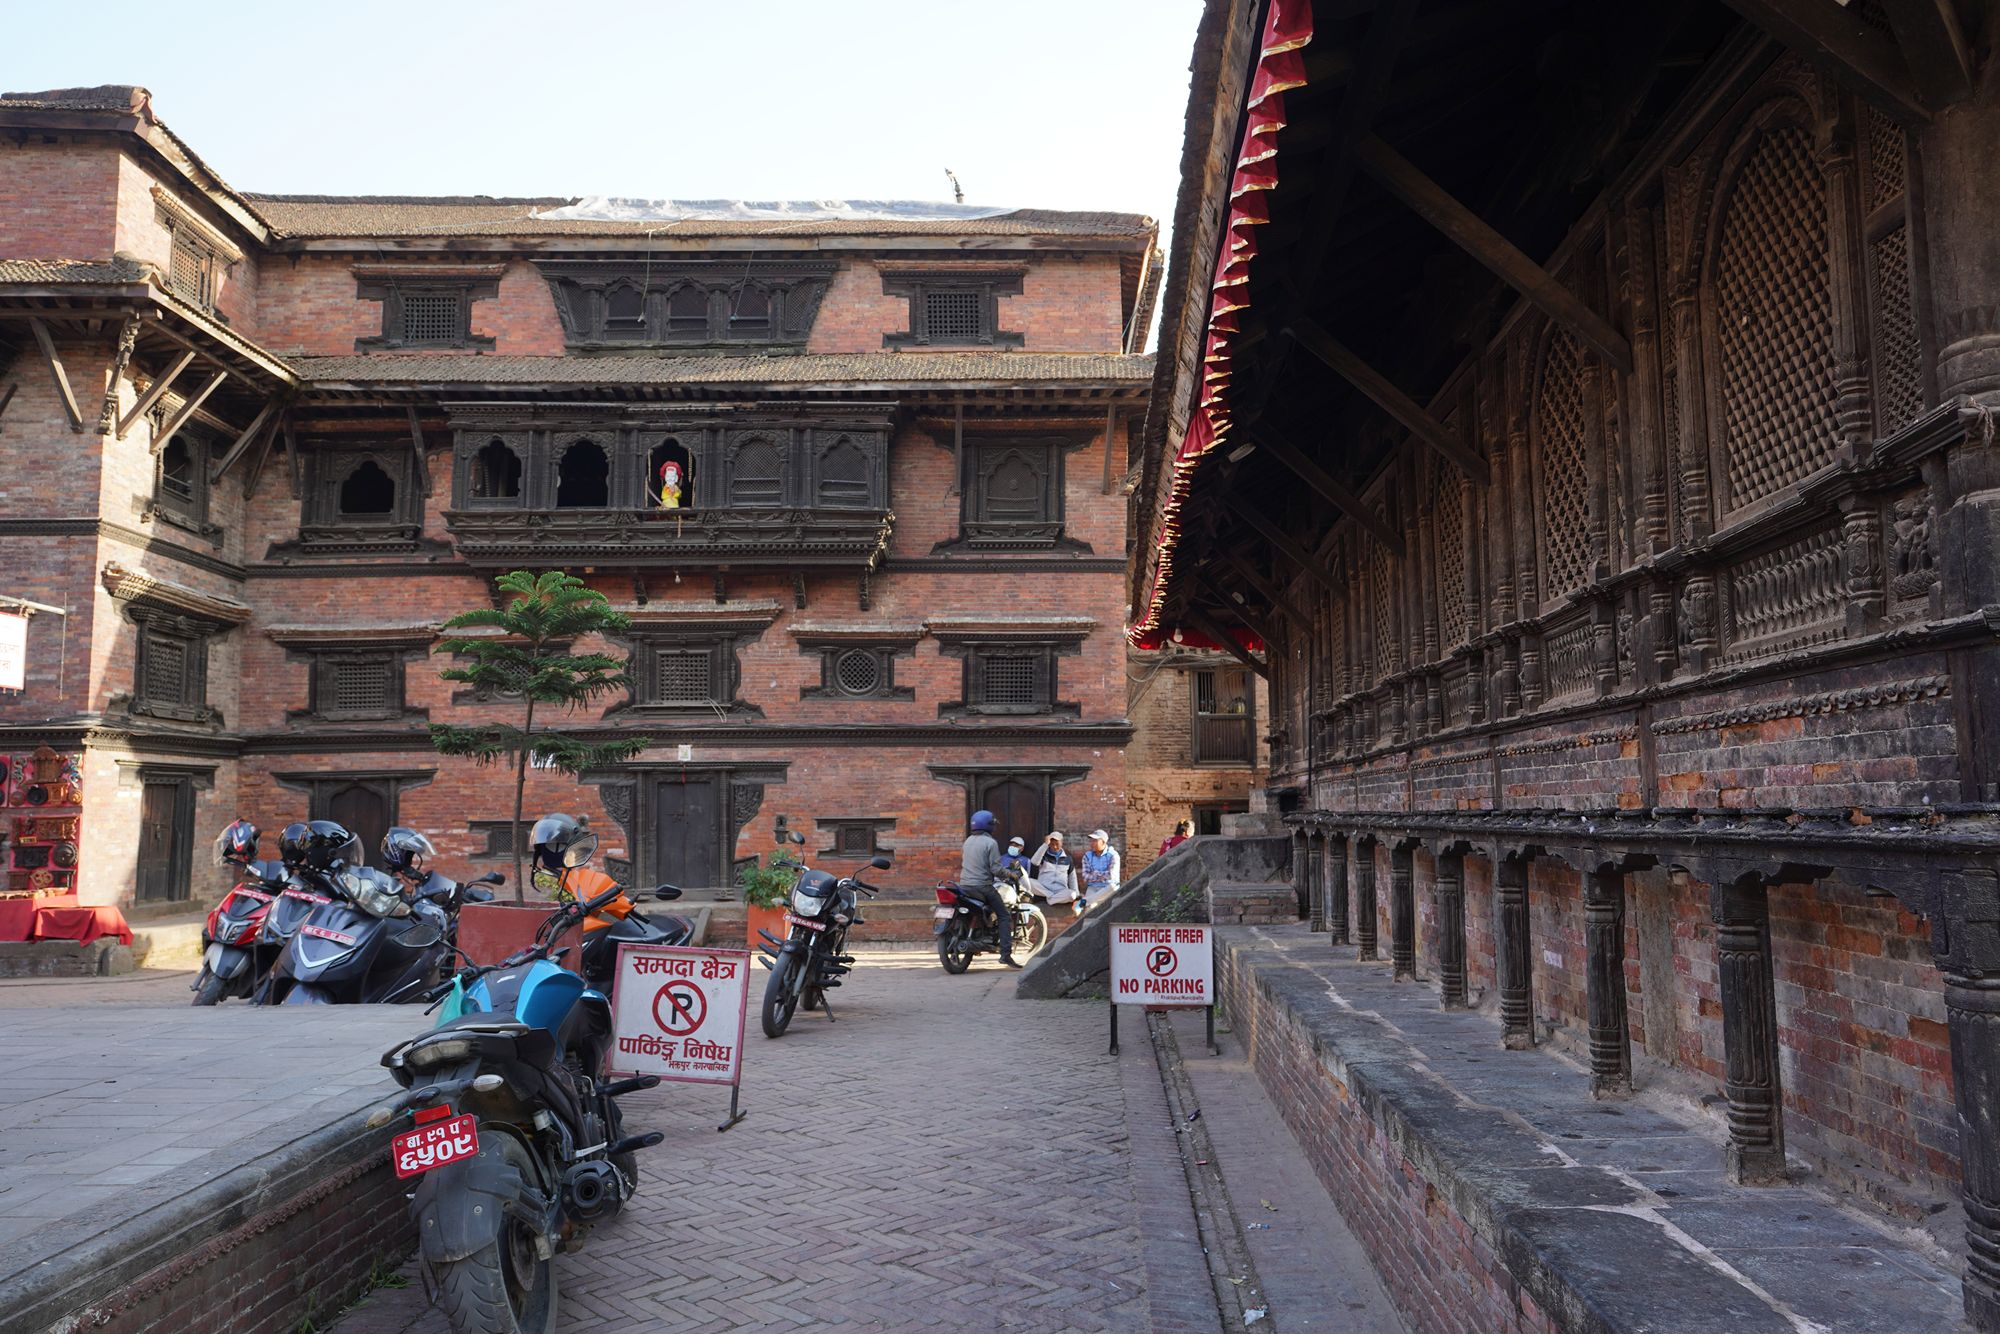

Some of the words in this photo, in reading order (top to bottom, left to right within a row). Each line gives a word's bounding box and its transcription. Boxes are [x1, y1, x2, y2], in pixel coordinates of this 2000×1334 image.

[1119, 928, 1171, 943] HERITAGE
[1175, 929, 1203, 943] AREA
[633, 956, 695, 977] सम्पदा
[701, 955, 737, 980] क्षेत्र
[1120, 979, 1139, 993] NO
[1144, 979, 1204, 994] PARKING
[683, 1038, 732, 1062] निषेध
[449, 1121, 460, 1134] प
